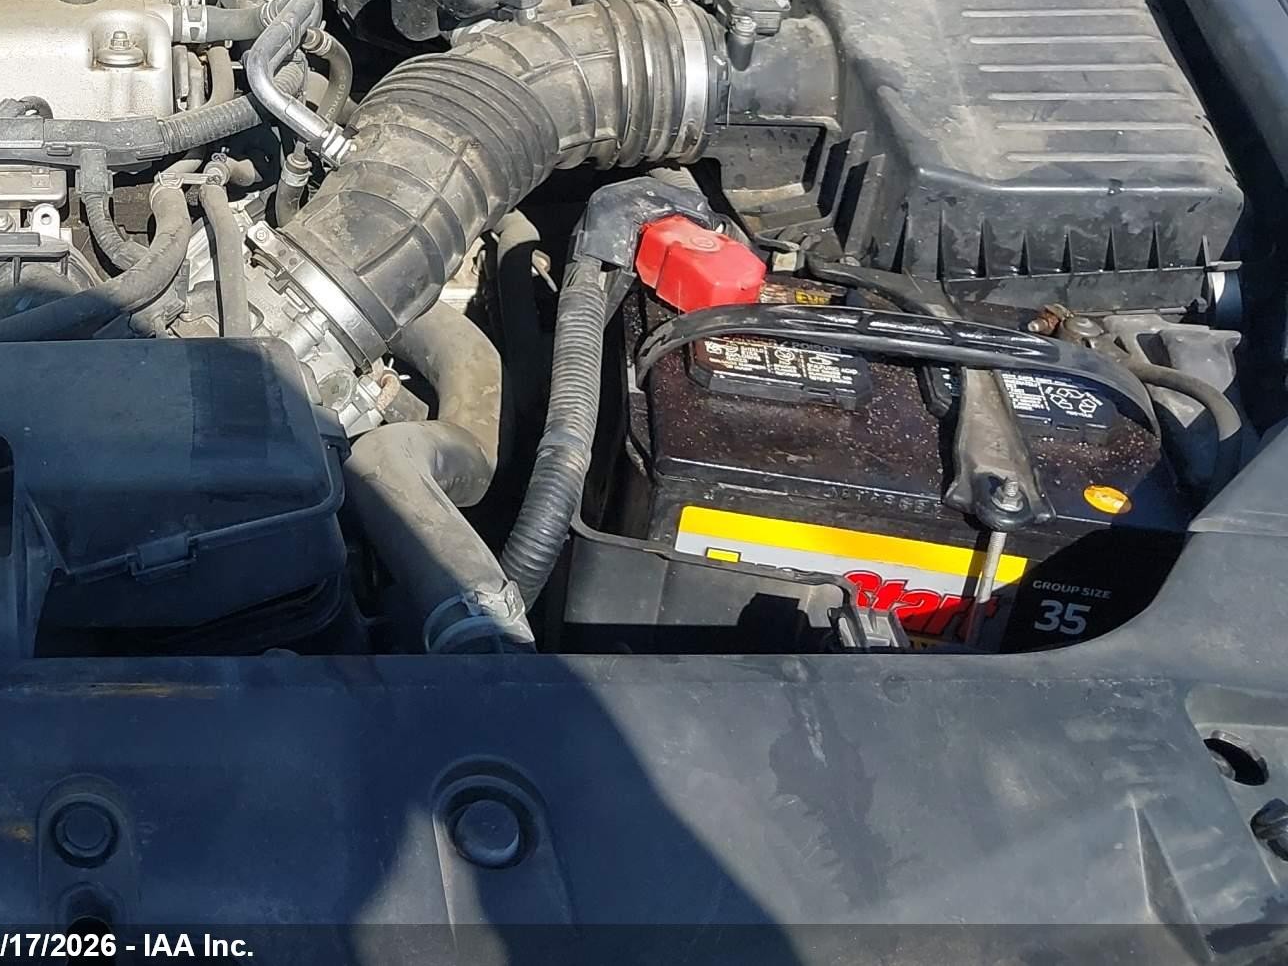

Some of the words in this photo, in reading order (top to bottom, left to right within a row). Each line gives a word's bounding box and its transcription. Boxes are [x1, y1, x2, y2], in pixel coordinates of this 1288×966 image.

[1032, 580, 1079, 594] GROUP
[1081, 587, 1112, 599] SIZE
[1034, 599, 1091, 635] 35
